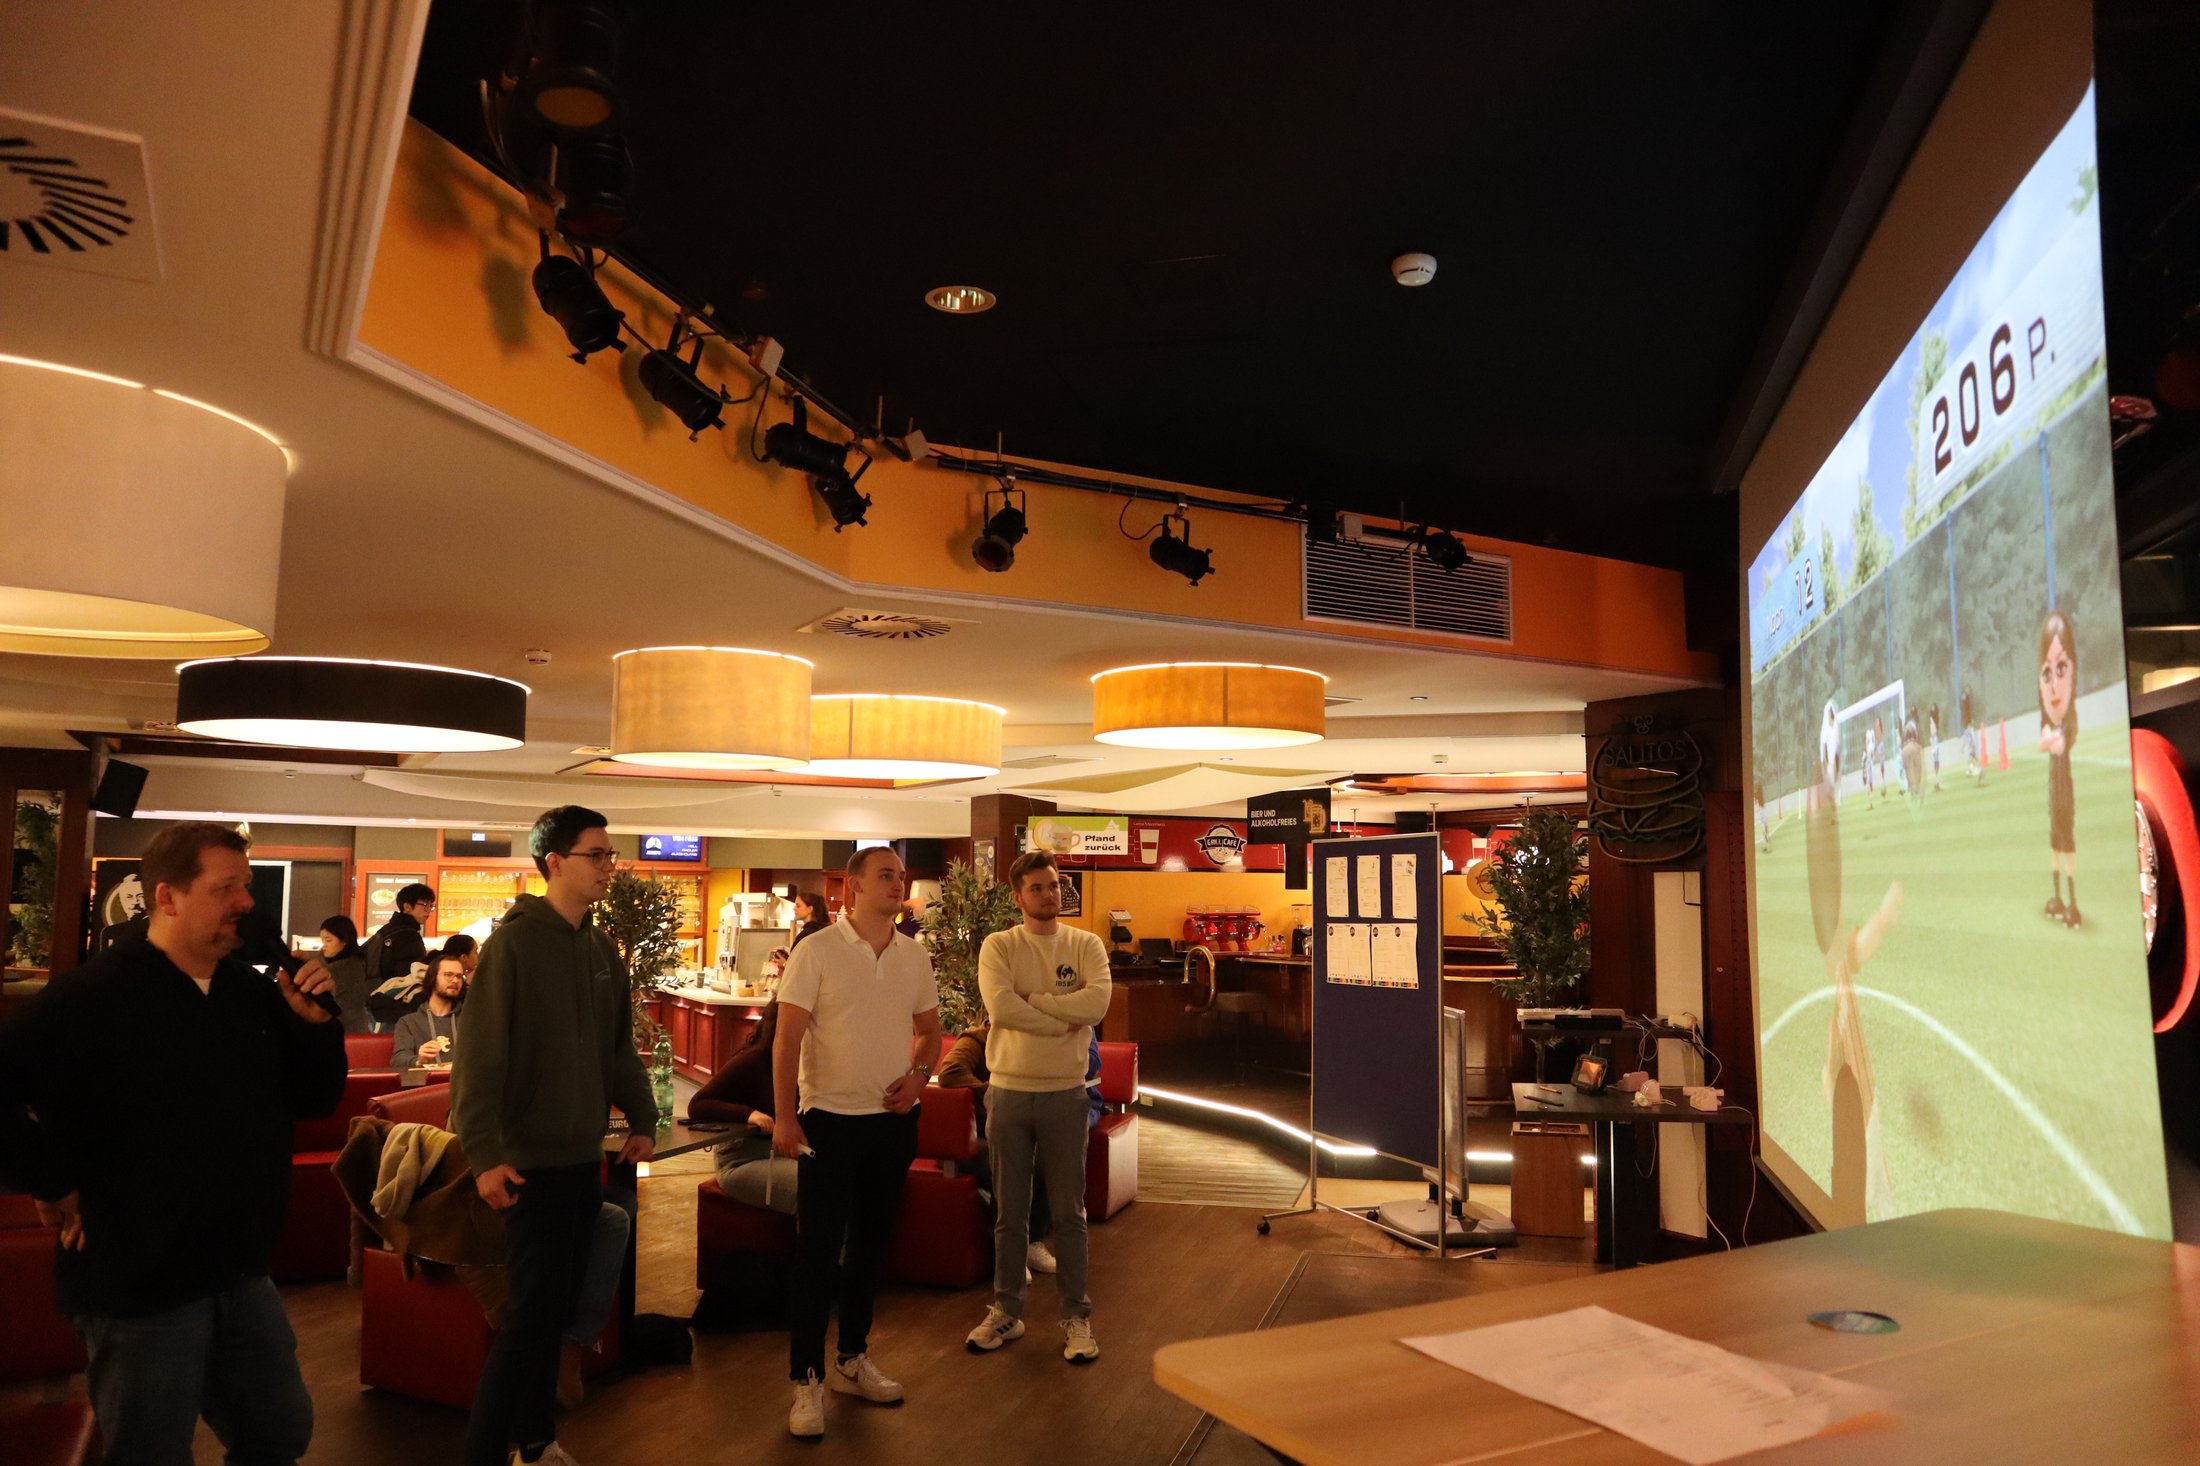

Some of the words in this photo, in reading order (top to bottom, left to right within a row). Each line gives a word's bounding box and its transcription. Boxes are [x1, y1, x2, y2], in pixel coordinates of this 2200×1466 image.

[1932, 323, 2016, 477] 206
[2028, 315, 2056, 382] P.
[1795, 558, 1814, 616] 12
[1603, 739, 1687, 767] SALITOS
[1251, 810, 1263, 819] BIER
[1263, 809, 1276, 818] UND
[1251, 818, 1297, 827] ALKOHOLFREIES
[1084, 834, 1116, 843] Pfand
[1084, 843, 1121, 852] zurück
